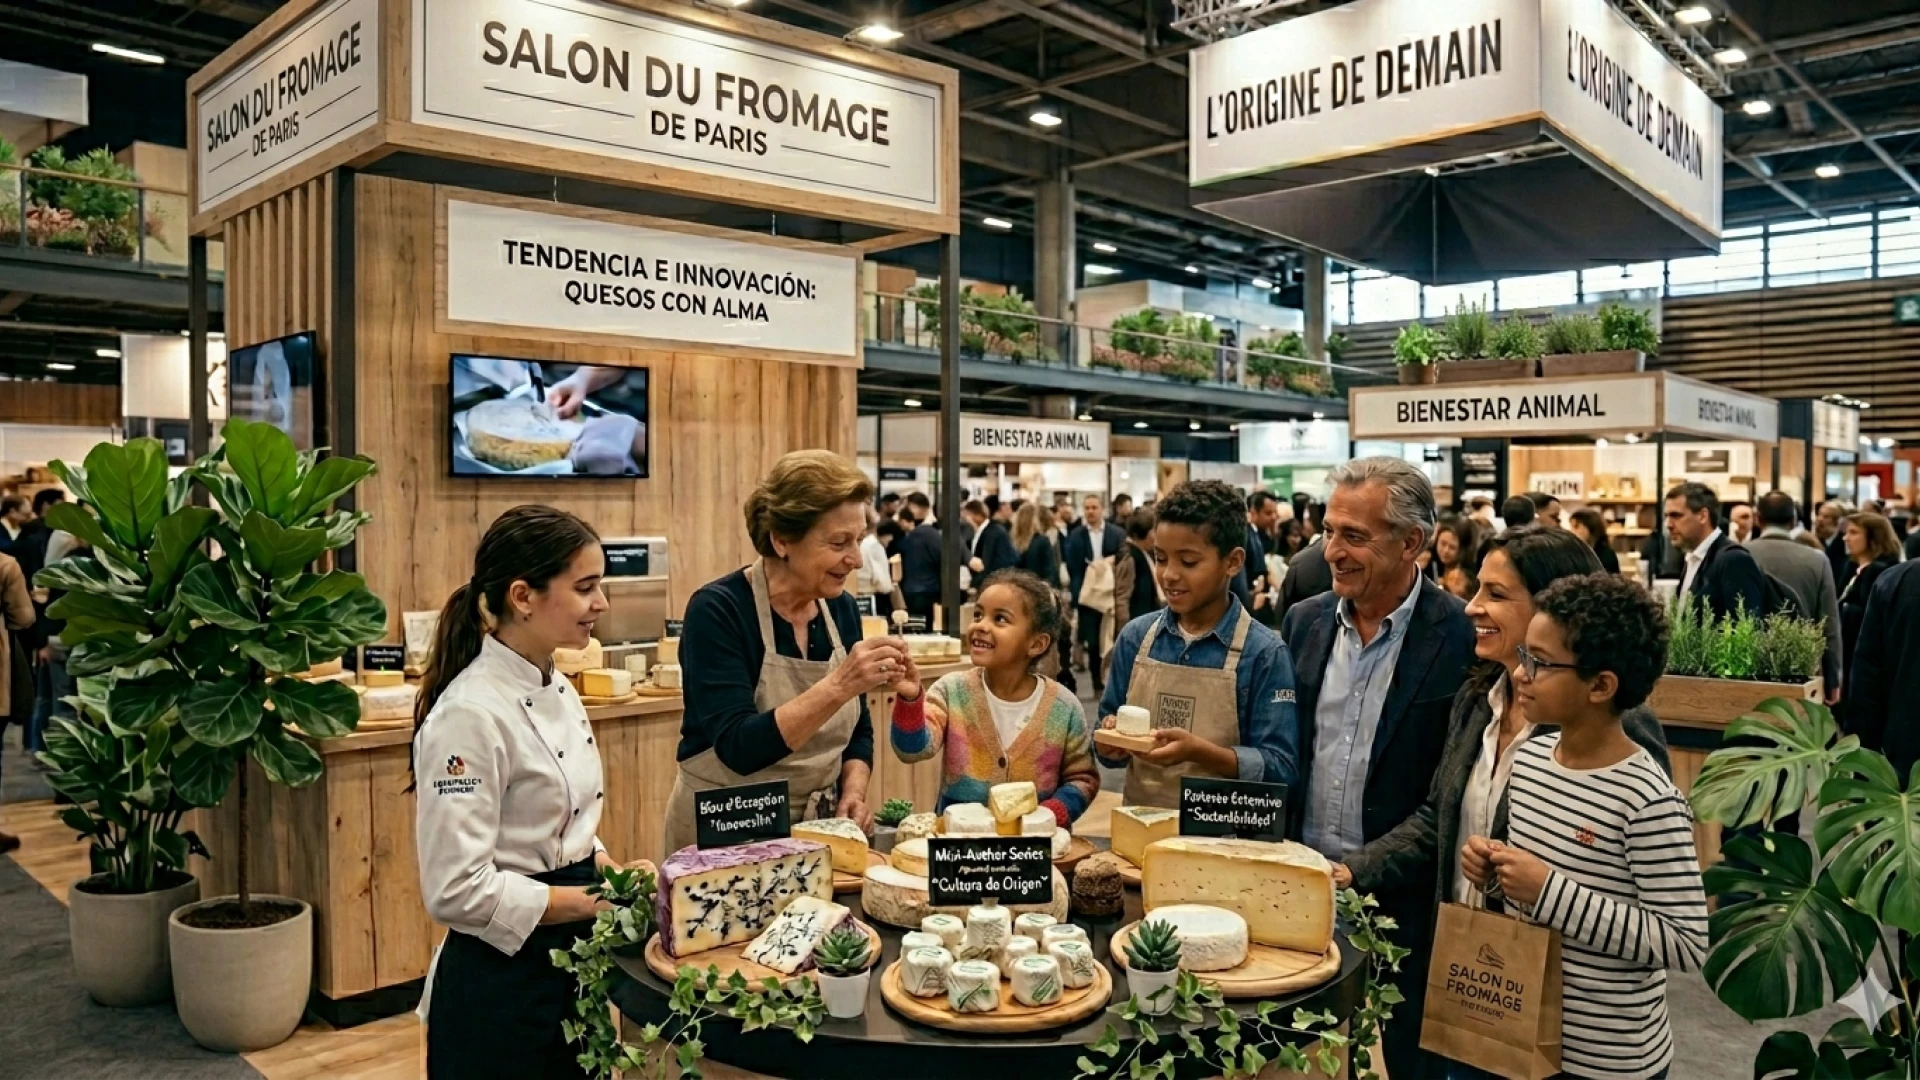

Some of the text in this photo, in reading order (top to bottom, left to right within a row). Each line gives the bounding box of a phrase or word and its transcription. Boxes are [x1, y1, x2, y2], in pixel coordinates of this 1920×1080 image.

[207, 20, 362, 152] SALON DU FROMAGE
[482, 20, 891, 146] SALON DU FROMAGE
[1206, 18, 1502, 139] L'ORIGINE DE DEMAIN
[1567, 24, 1633, 129] L'ORIGINE
[1637, 83, 1654, 145] DE
[252, 111, 300, 157] DE PARIS
[650, 109, 769, 157] DE PARIS
[502, 239, 817, 300] TENDENCIA E INNOVACIÓN:
[564, 279, 769, 323] QUESOS CON ALMA
[1396, 392, 1607, 424] BIENESTAR ANIMAL
[973, 427, 1092, 451] BIENESTAR ANIMAL
[1446, 978, 1522, 1013] FROMAGE
[1448, 962, 1525, 995] SALON DU
